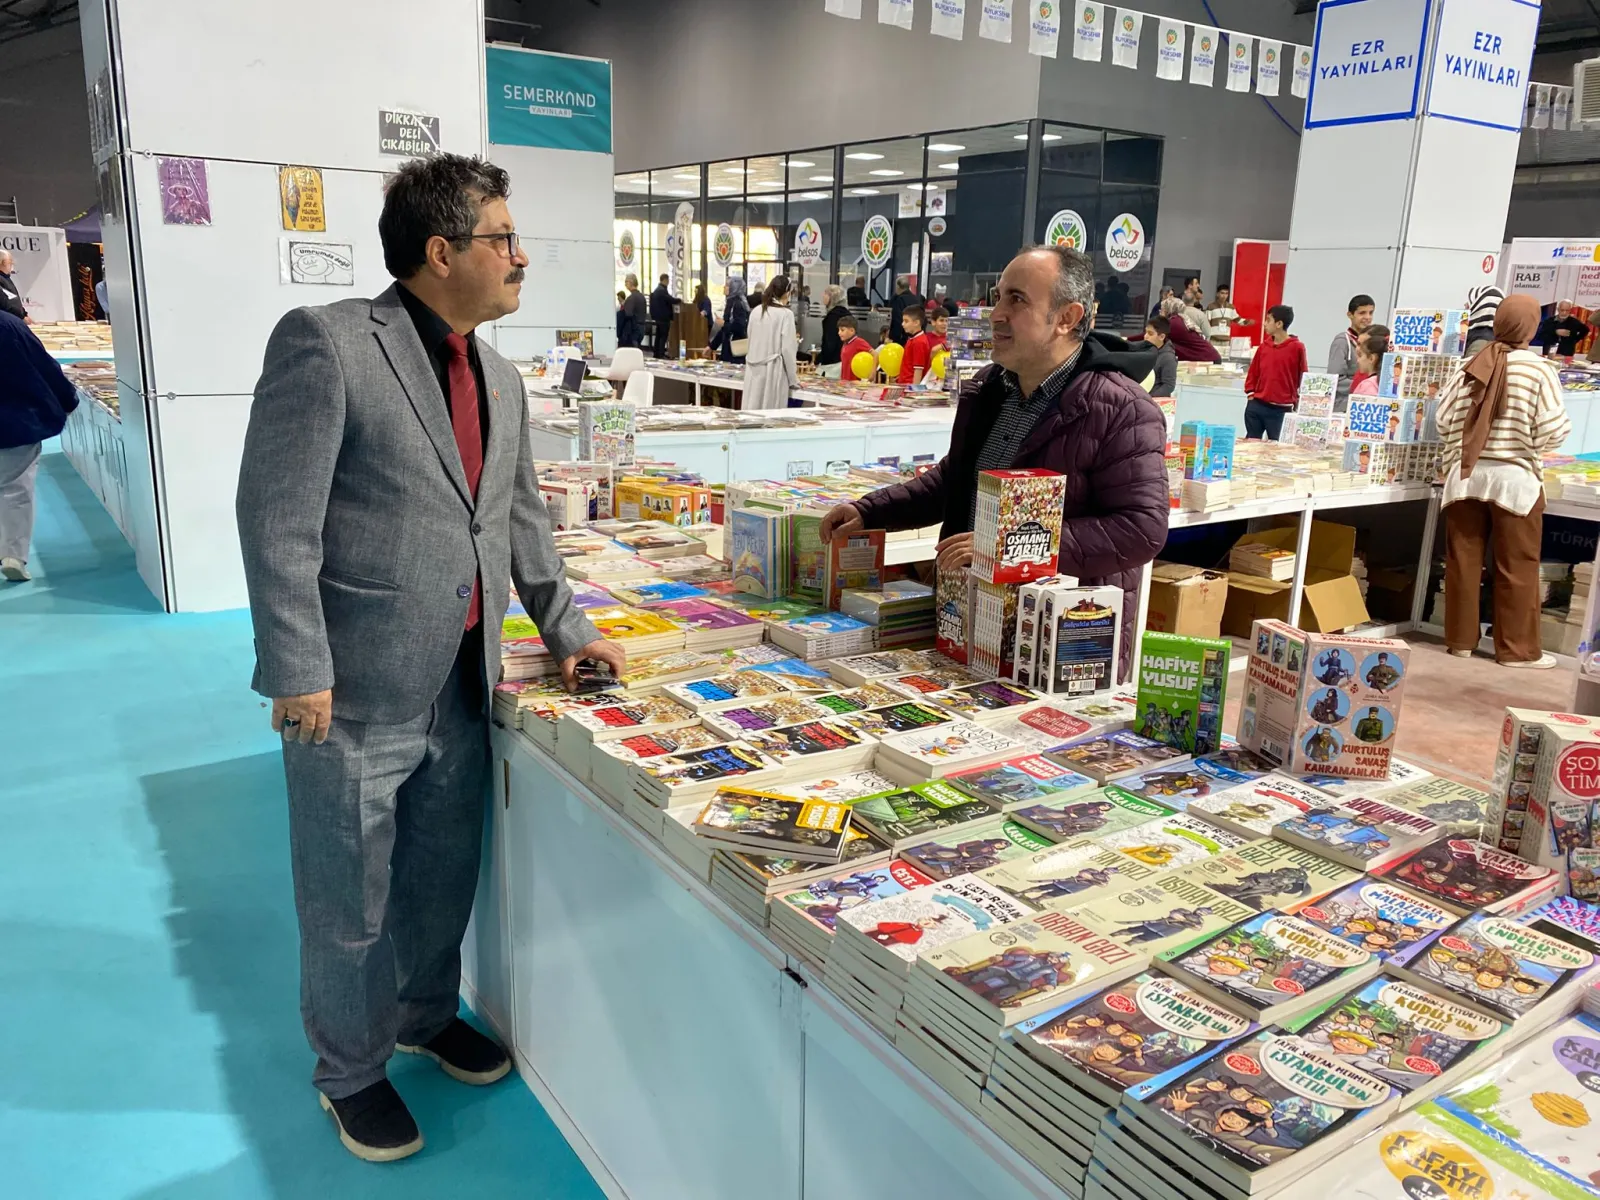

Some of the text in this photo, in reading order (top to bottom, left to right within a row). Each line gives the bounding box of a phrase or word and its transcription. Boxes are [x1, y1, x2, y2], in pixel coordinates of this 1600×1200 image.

[1351, 40, 1384, 57] EZR
[1473, 31, 1502, 55] EZR
[1321, 55, 1413, 80] YAYINLARI
[1445, 53, 1521, 87] YAYINLARI
[503, 84, 596, 107] SEMERKAND
[0, 236, 41, 252] GUE
[1109, 245, 1139, 259] belsos
[1116, 260, 1130, 268] cafe
[1516, 272, 1541, 281] RAB
[1394, 335, 1430, 346] DİZİSİ
[1350, 422, 1386, 433] DİZİSİ
[1007, 533, 1051, 546] OSMANLI
[1007, 543, 1049, 558] TARİHİ
[1142, 654, 1199, 674] HAFİYE
[1142, 670, 1198, 691] YUSUF
[1341, 744, 1390, 760] KURTULUŞ
[1304, 762, 1387, 779] KAHRAMANLARI
[1355, 756, 1388, 770] SAVAŞI
